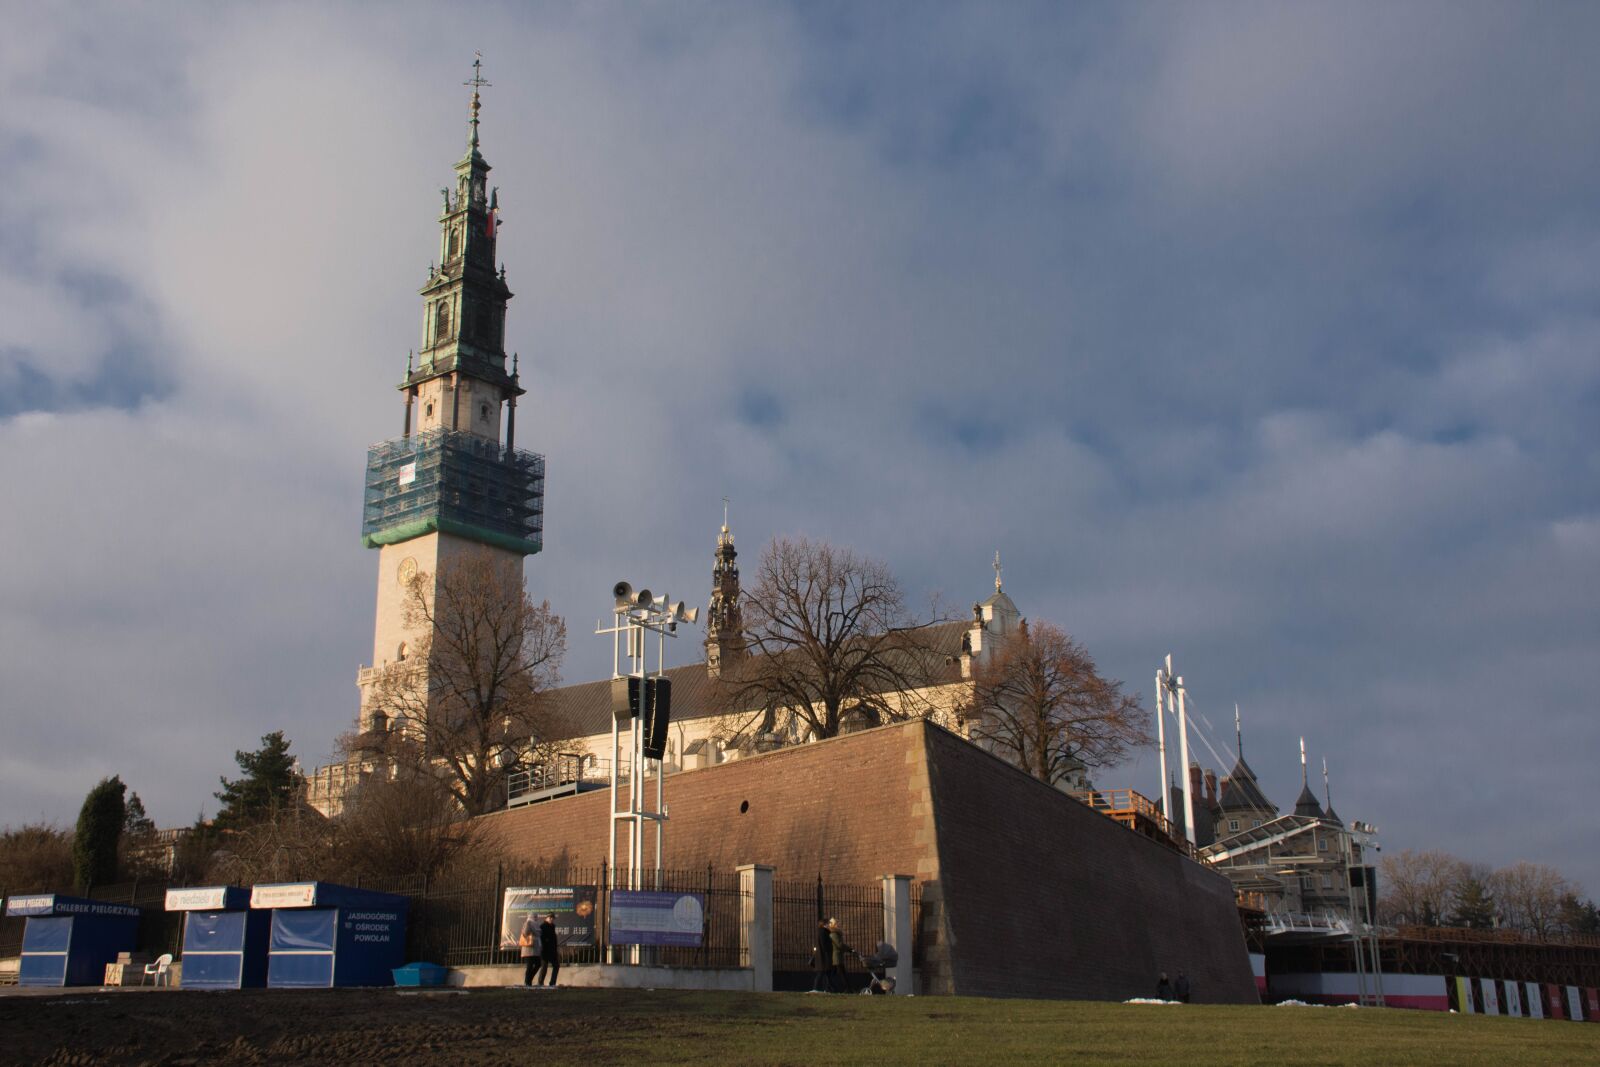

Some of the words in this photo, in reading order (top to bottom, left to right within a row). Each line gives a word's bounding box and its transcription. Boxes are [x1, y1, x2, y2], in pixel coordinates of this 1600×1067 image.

[55, 904, 89, 912] CHLEBEK
[91, 905, 139, 915] PIELGRZYMA
[347, 911, 397, 920] JASNOGÓRSKI
[355, 921, 390, 931] OŚRODEK
